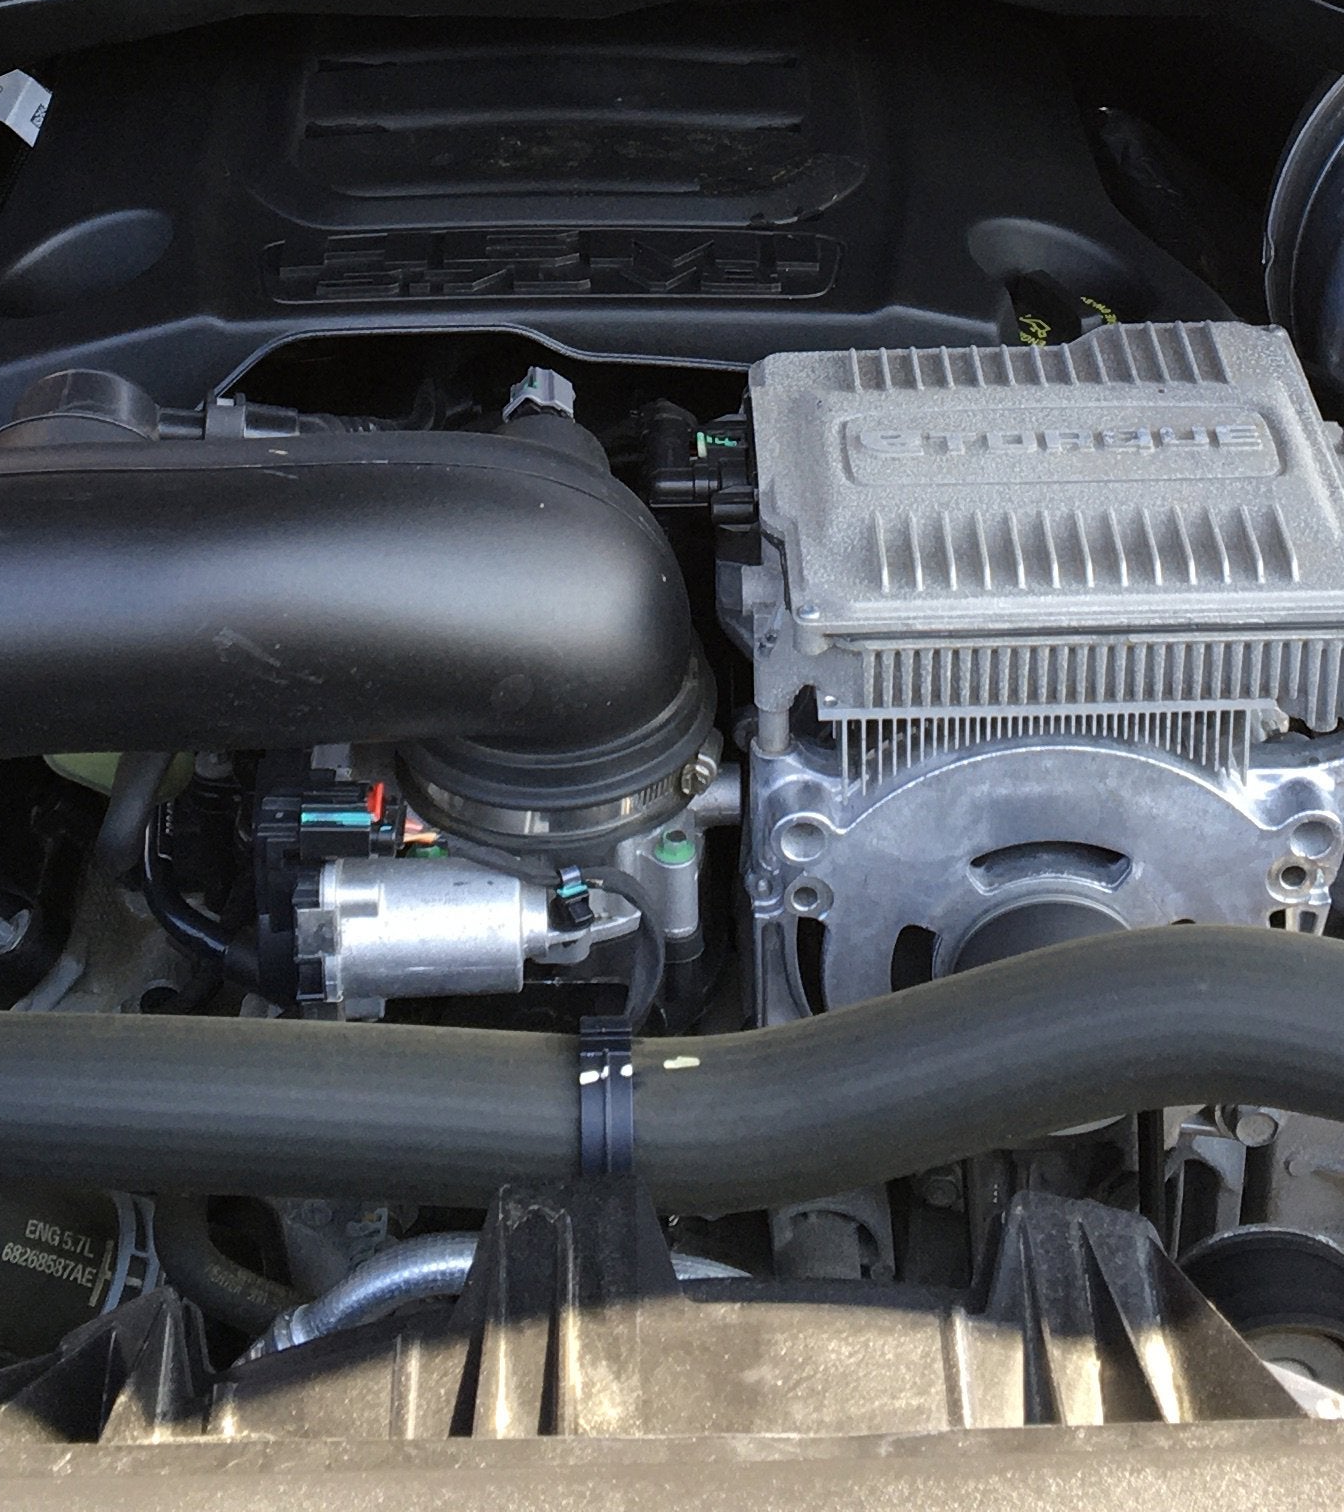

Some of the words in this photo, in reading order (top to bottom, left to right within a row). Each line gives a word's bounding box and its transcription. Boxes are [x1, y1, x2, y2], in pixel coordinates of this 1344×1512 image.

[25, 1219, 61, 1246] ENG
[62, 1231, 94, 1258] 5.7L
[1, 1242, 96, 1287] 68268587AE
